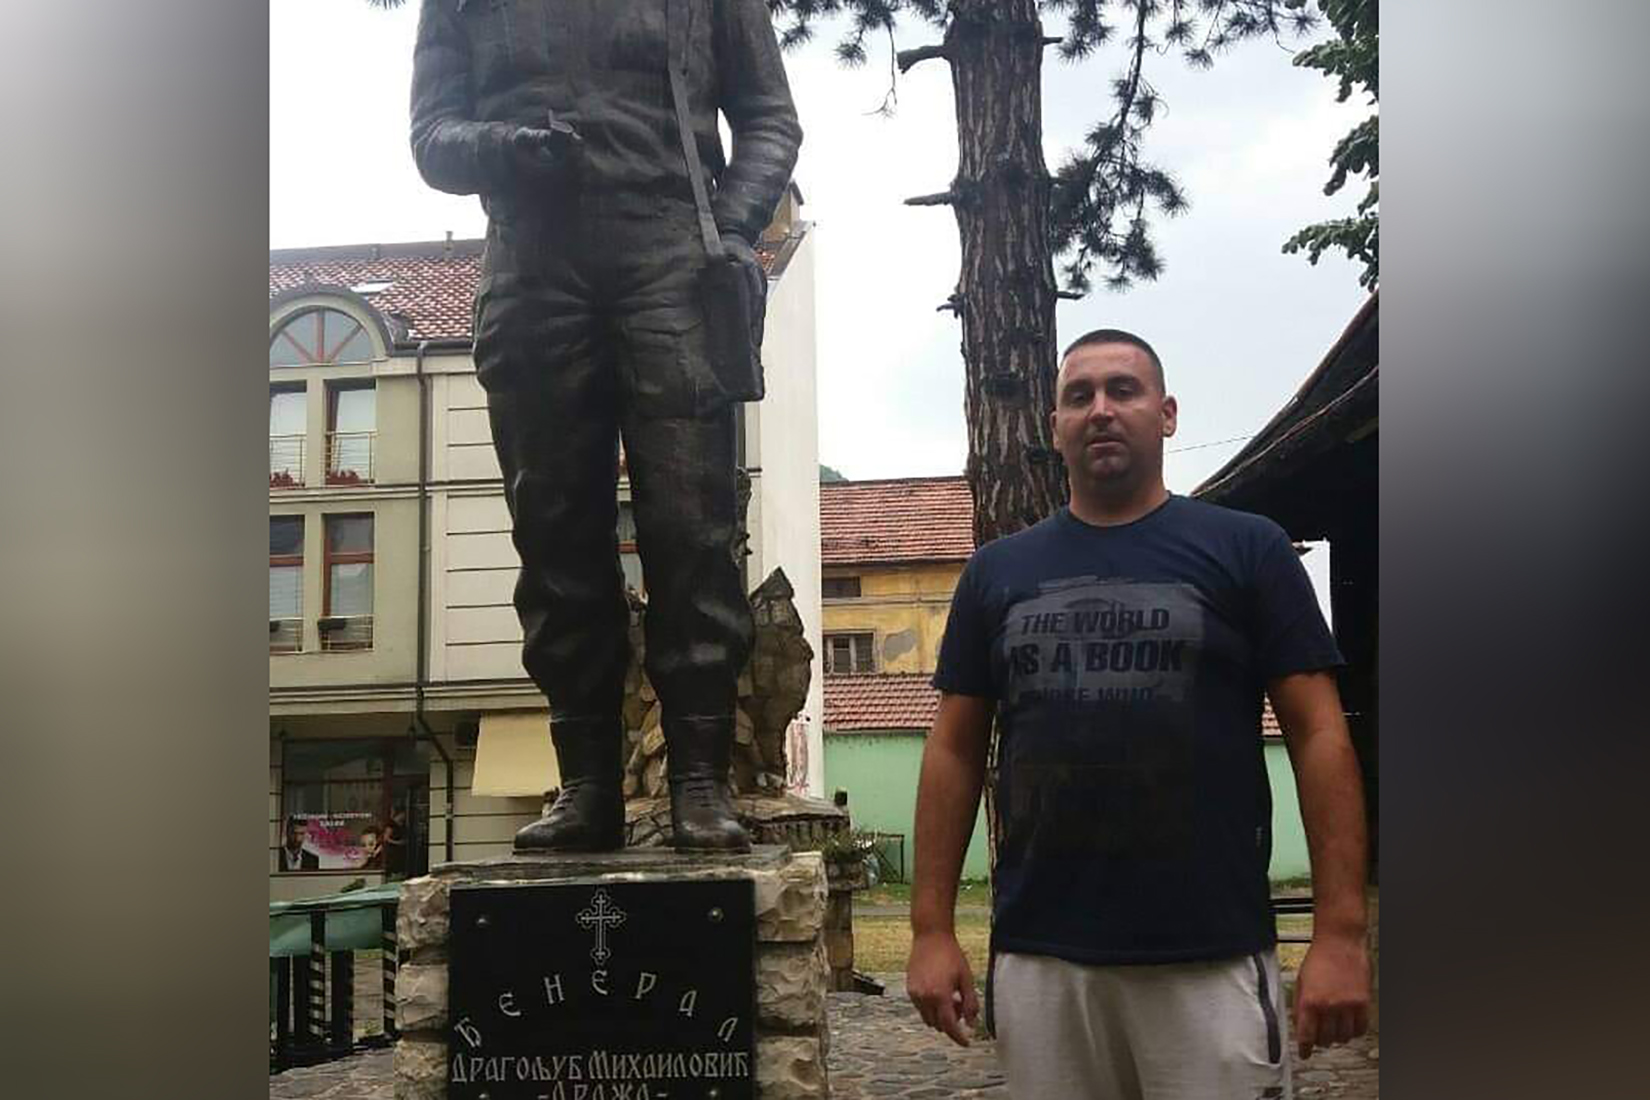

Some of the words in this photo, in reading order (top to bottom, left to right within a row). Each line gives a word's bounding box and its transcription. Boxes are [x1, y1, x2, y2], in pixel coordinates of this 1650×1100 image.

[1021, 612, 1065, 635] THE
[1073, 608, 1169, 634] WORLD
[1010, 642, 1040, 675] IS
[1050, 641, 1073, 673] A
[1084, 640, 1184, 673] BOOK
